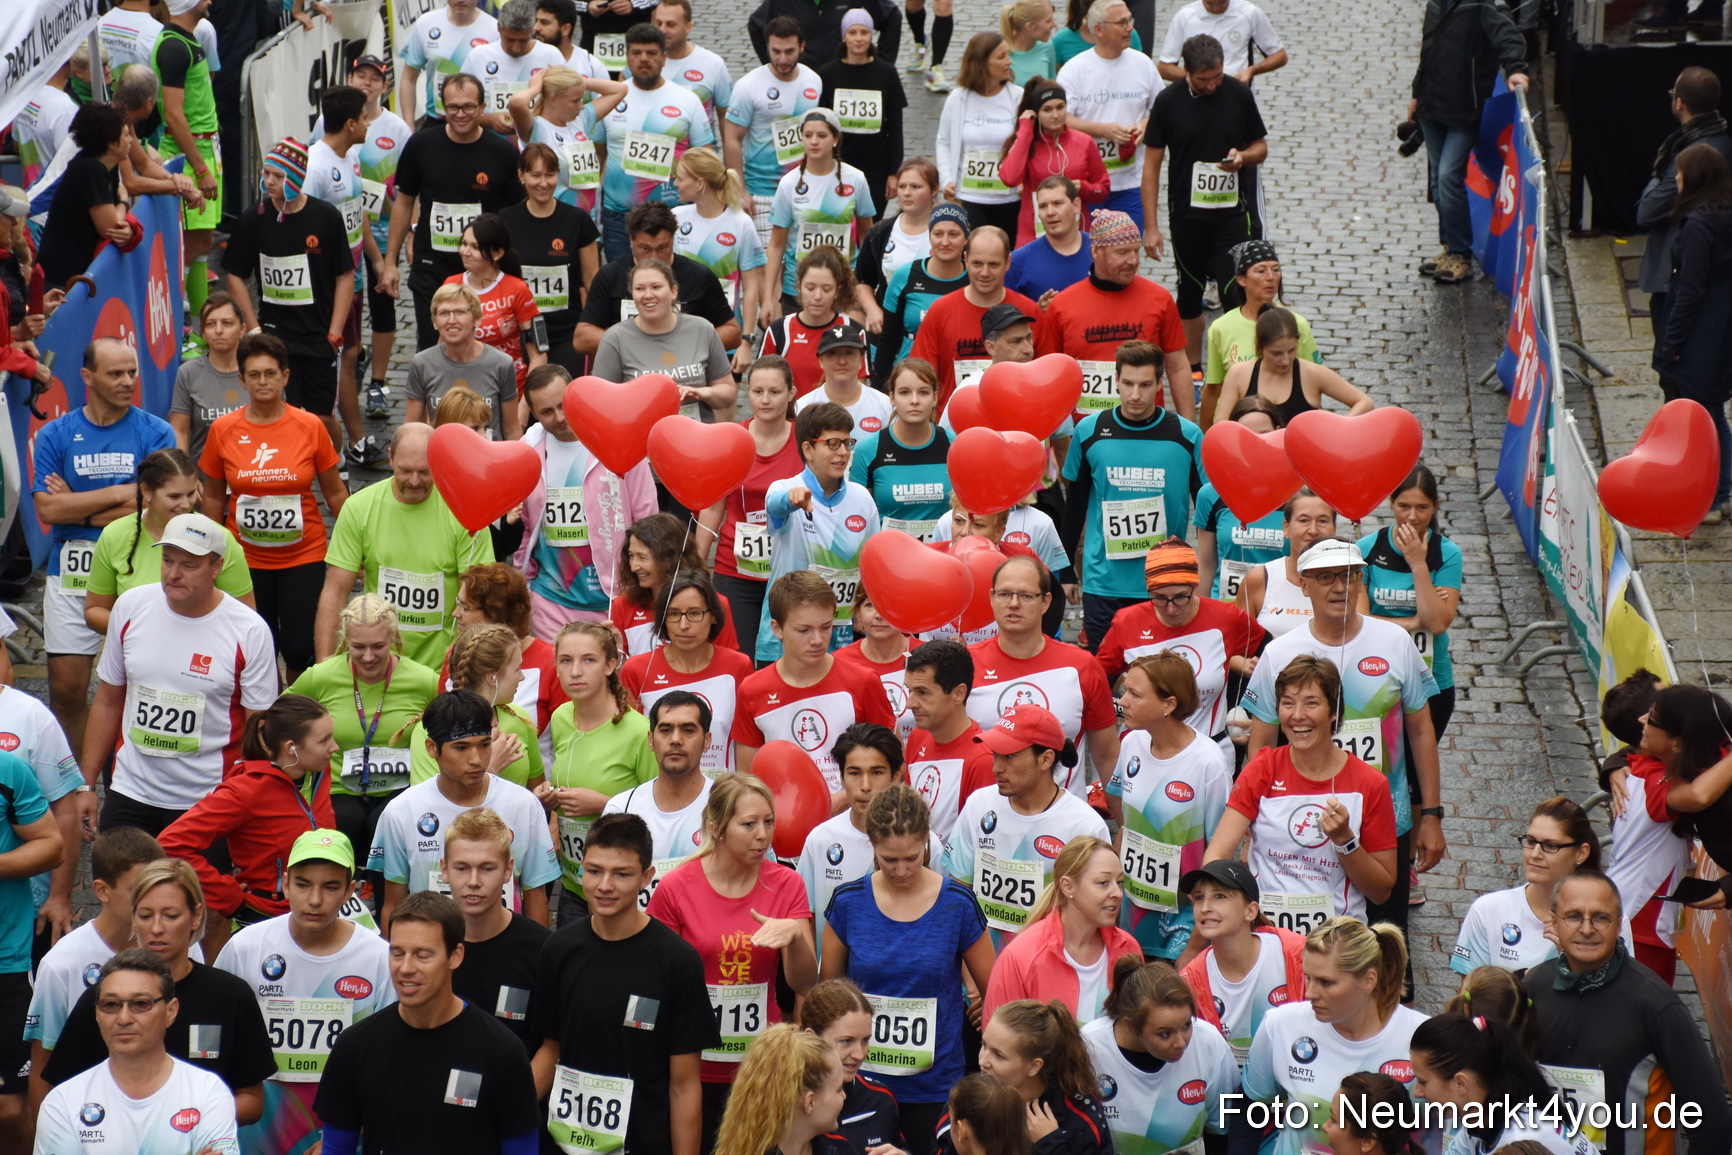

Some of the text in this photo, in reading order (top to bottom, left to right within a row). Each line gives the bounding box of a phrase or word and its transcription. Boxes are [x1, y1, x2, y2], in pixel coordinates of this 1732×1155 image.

[3, 46, 41, 89] PARTL
[39, 4, 83, 53] Neumarkt
[598, 41, 626, 57] 518
[838, 100, 877, 117] 5133
[628, 141, 670, 164] 5247
[1098, 141, 1116, 158] 52
[572, 153, 598, 172] 5149
[967, 160, 998, 176] 527
[977, 181, 993, 189] Irene
[1197, 174, 1236, 190] 5073
[1202, 194, 1228, 202] Andreas
[443, 237, 461, 245] Norb
[264, 268, 304, 287] 5027
[275, 291, 295, 299] Aaron
[480, 295, 515, 312] raun
[1089, 399, 1115, 408] Günter
[201, 407, 242, 421] LEHM
[860, 419, 881, 429] Hervis
[74, 453, 134, 468] HUBER
[237, 467, 289, 480] funrunners
[251, 472, 297, 483] neumarkt
[1107, 467, 1165, 481] HUBER
[892, 483, 944, 495] HUBER
[243, 508, 296, 530] 5322
[546, 502, 587, 524] 512
[846, 519, 866, 529] Hervis
[1109, 512, 1160, 537] 5157
[186, 526, 207, 538] HUBER
[557, 528, 584, 539] Haserl
[1231, 527, 1284, 540] HUBER
[1008, 534, 1029, 545] Hervis
[1122, 539, 1150, 551] Patrick
[67, 549, 92, 573] 50
[757, 562, 772, 572] Tin
[72, 577, 88, 588] Ber
[384, 583, 440, 609] 5099
[1373, 586, 1417, 600] HUBE
[1285, 608, 1314, 616] KLE
[191, 665, 208, 673] DKMS
[1361, 659, 1388, 672] Hervis
[161, 692, 199, 703] BOCK
[136, 701, 196, 734] 5220
[1341, 721, 1373, 732] BOCK
[0, 735, 17, 747] rvis
[143, 734, 179, 750] Helmut
[373, 749, 405, 757] BOCK
[1167, 785, 1191, 799] Hervis
[1038, 840, 1064, 854] Hervis
[1144, 842, 1174, 856] BOCK
[1268, 851, 1341, 868] LAUFEN MIT HERZ
[999, 861, 1036, 873] BOCK
[1123, 848, 1170, 886] 5151
[1274, 868, 1329, 882] Leistungsdiagnost
[980, 868, 1036, 907] 5225
[1129, 880, 1161, 903] Susanne
[1287, 895, 1327, 907] BOCK
[984, 903, 1027, 924] Chodadad
[1263, 911, 1327, 934] 5053
[721, 932, 752, 951] WE
[258, 985, 284, 993] PARTL
[339, 980, 369, 996] Hervis
[723, 987, 761, 998] BOCK
[1272, 991, 1288, 1003] Her
[265, 1005, 295, 1013] NeuerMarkt
[300, 1001, 345, 1012] BOCK
[887, 999, 929, 1010] BOCK
[713, 1003, 760, 1033] 113
[269, 1018, 342, 1050] 5078
[874, 1014, 928, 1047] 050
[711, 1039, 746, 1052] eresa
[288, 1058, 318, 1071] Leon
[1288, 1065, 1315, 1077] PARTL
[1385, 1065, 1414, 1077] Hervis
[1553, 1070, 1595, 1083] BOCK
[583, 1076, 625, 1092] BOCK
[557, 1089, 622, 1131] 5168
[1101, 1106, 1120, 1114] RTL
[570, 1130, 595, 1148] Felix
[867, 1137, 882, 1146] Anne
